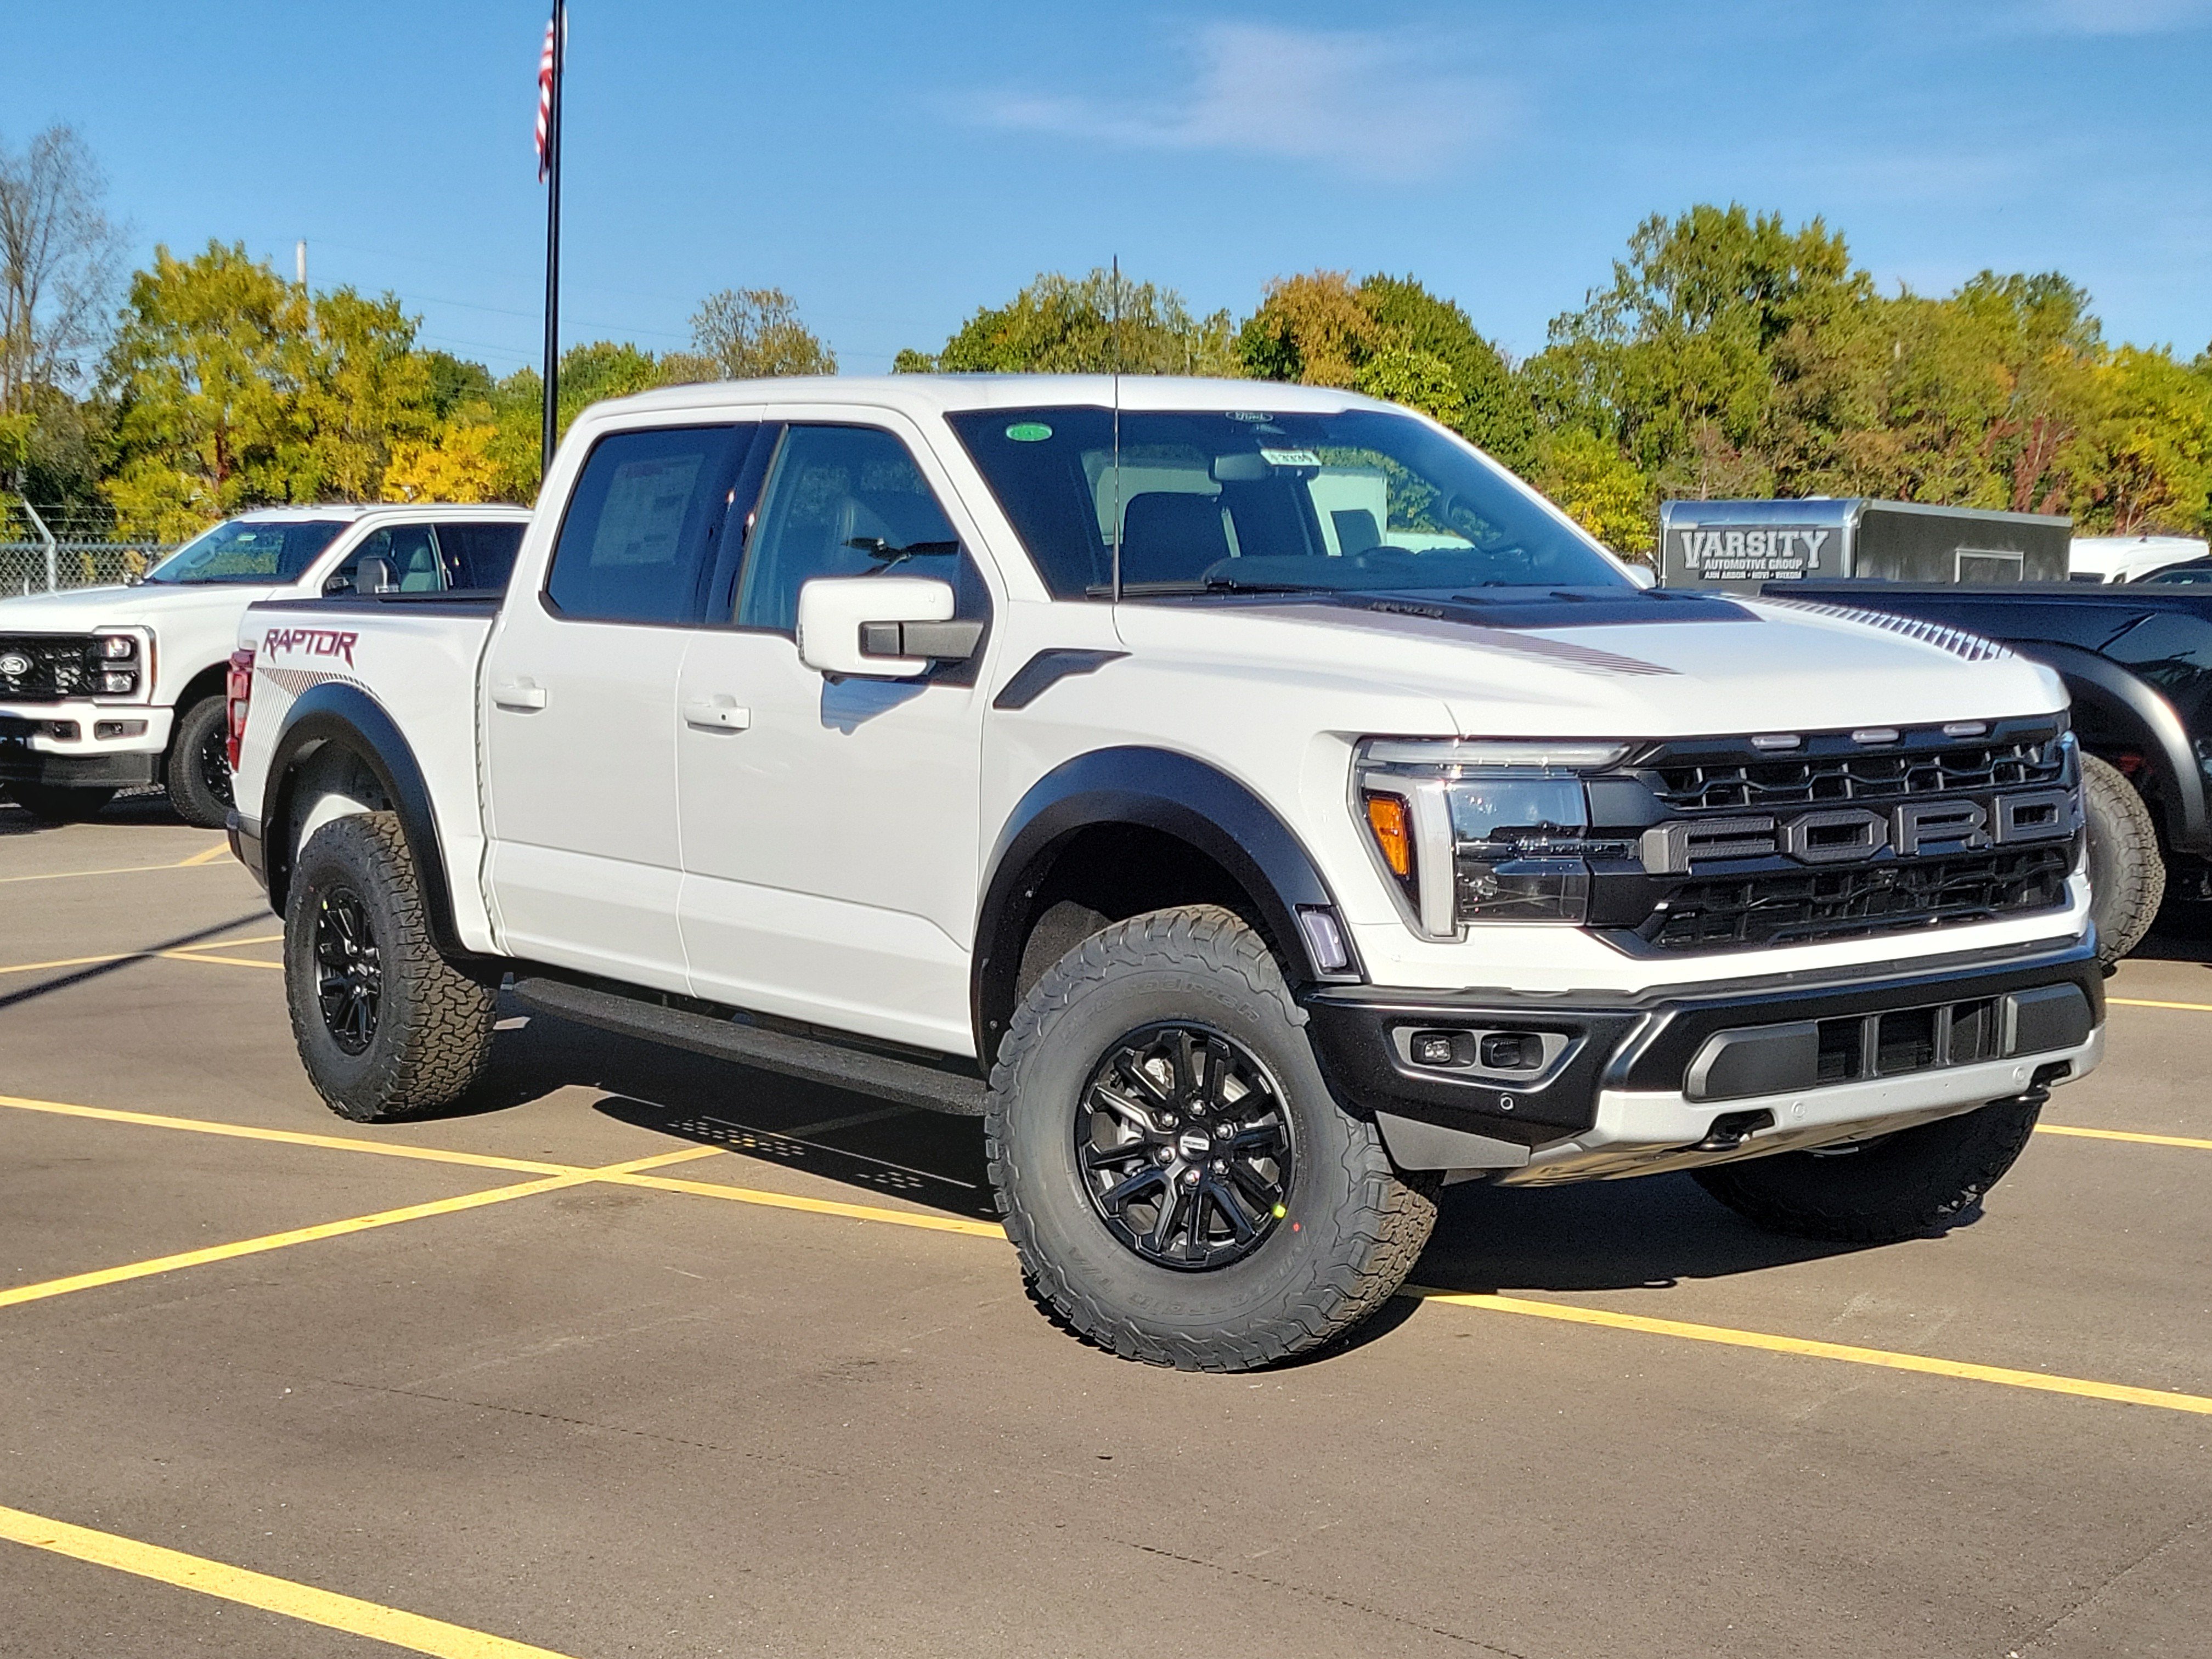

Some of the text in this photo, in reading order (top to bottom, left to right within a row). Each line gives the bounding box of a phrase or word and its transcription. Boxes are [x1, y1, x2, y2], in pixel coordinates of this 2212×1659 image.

[1680, 531, 1829, 568] VARSITY
[1704, 558, 1803, 569] AUTOMOTIVE GROUP
[263, 629, 359, 671] RAPTOR
[1640, 790, 2076, 876] FORD
